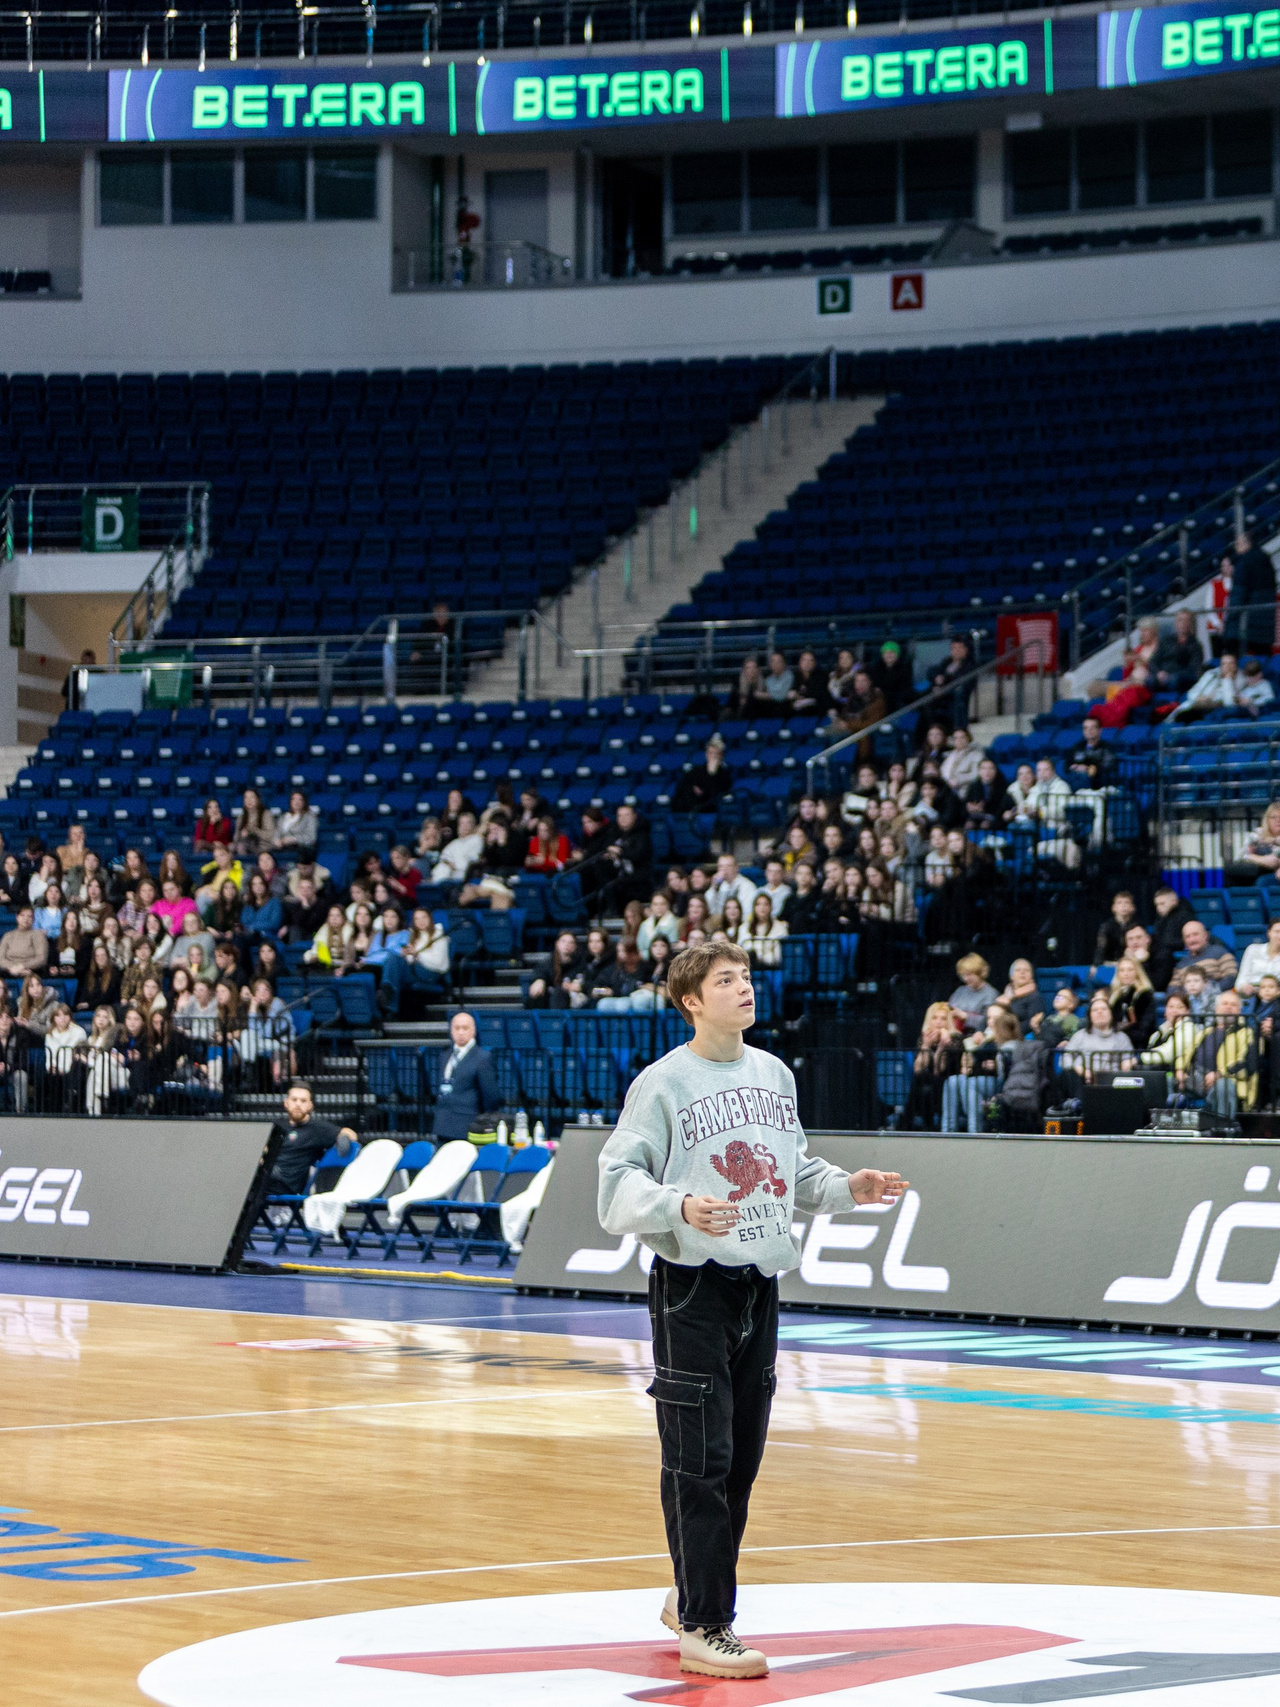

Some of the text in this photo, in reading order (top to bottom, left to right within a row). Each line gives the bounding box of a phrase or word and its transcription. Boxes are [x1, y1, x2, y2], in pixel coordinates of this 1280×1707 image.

[824, 284, 844, 310] D
[896, 280, 918, 306] A
[95, 506, 124, 541] D
[677, 1086, 797, 1151] CAMBRIDGE
[0, 1167, 90, 1226] GEL
[0, 1519, 311, 1582] ТБ
